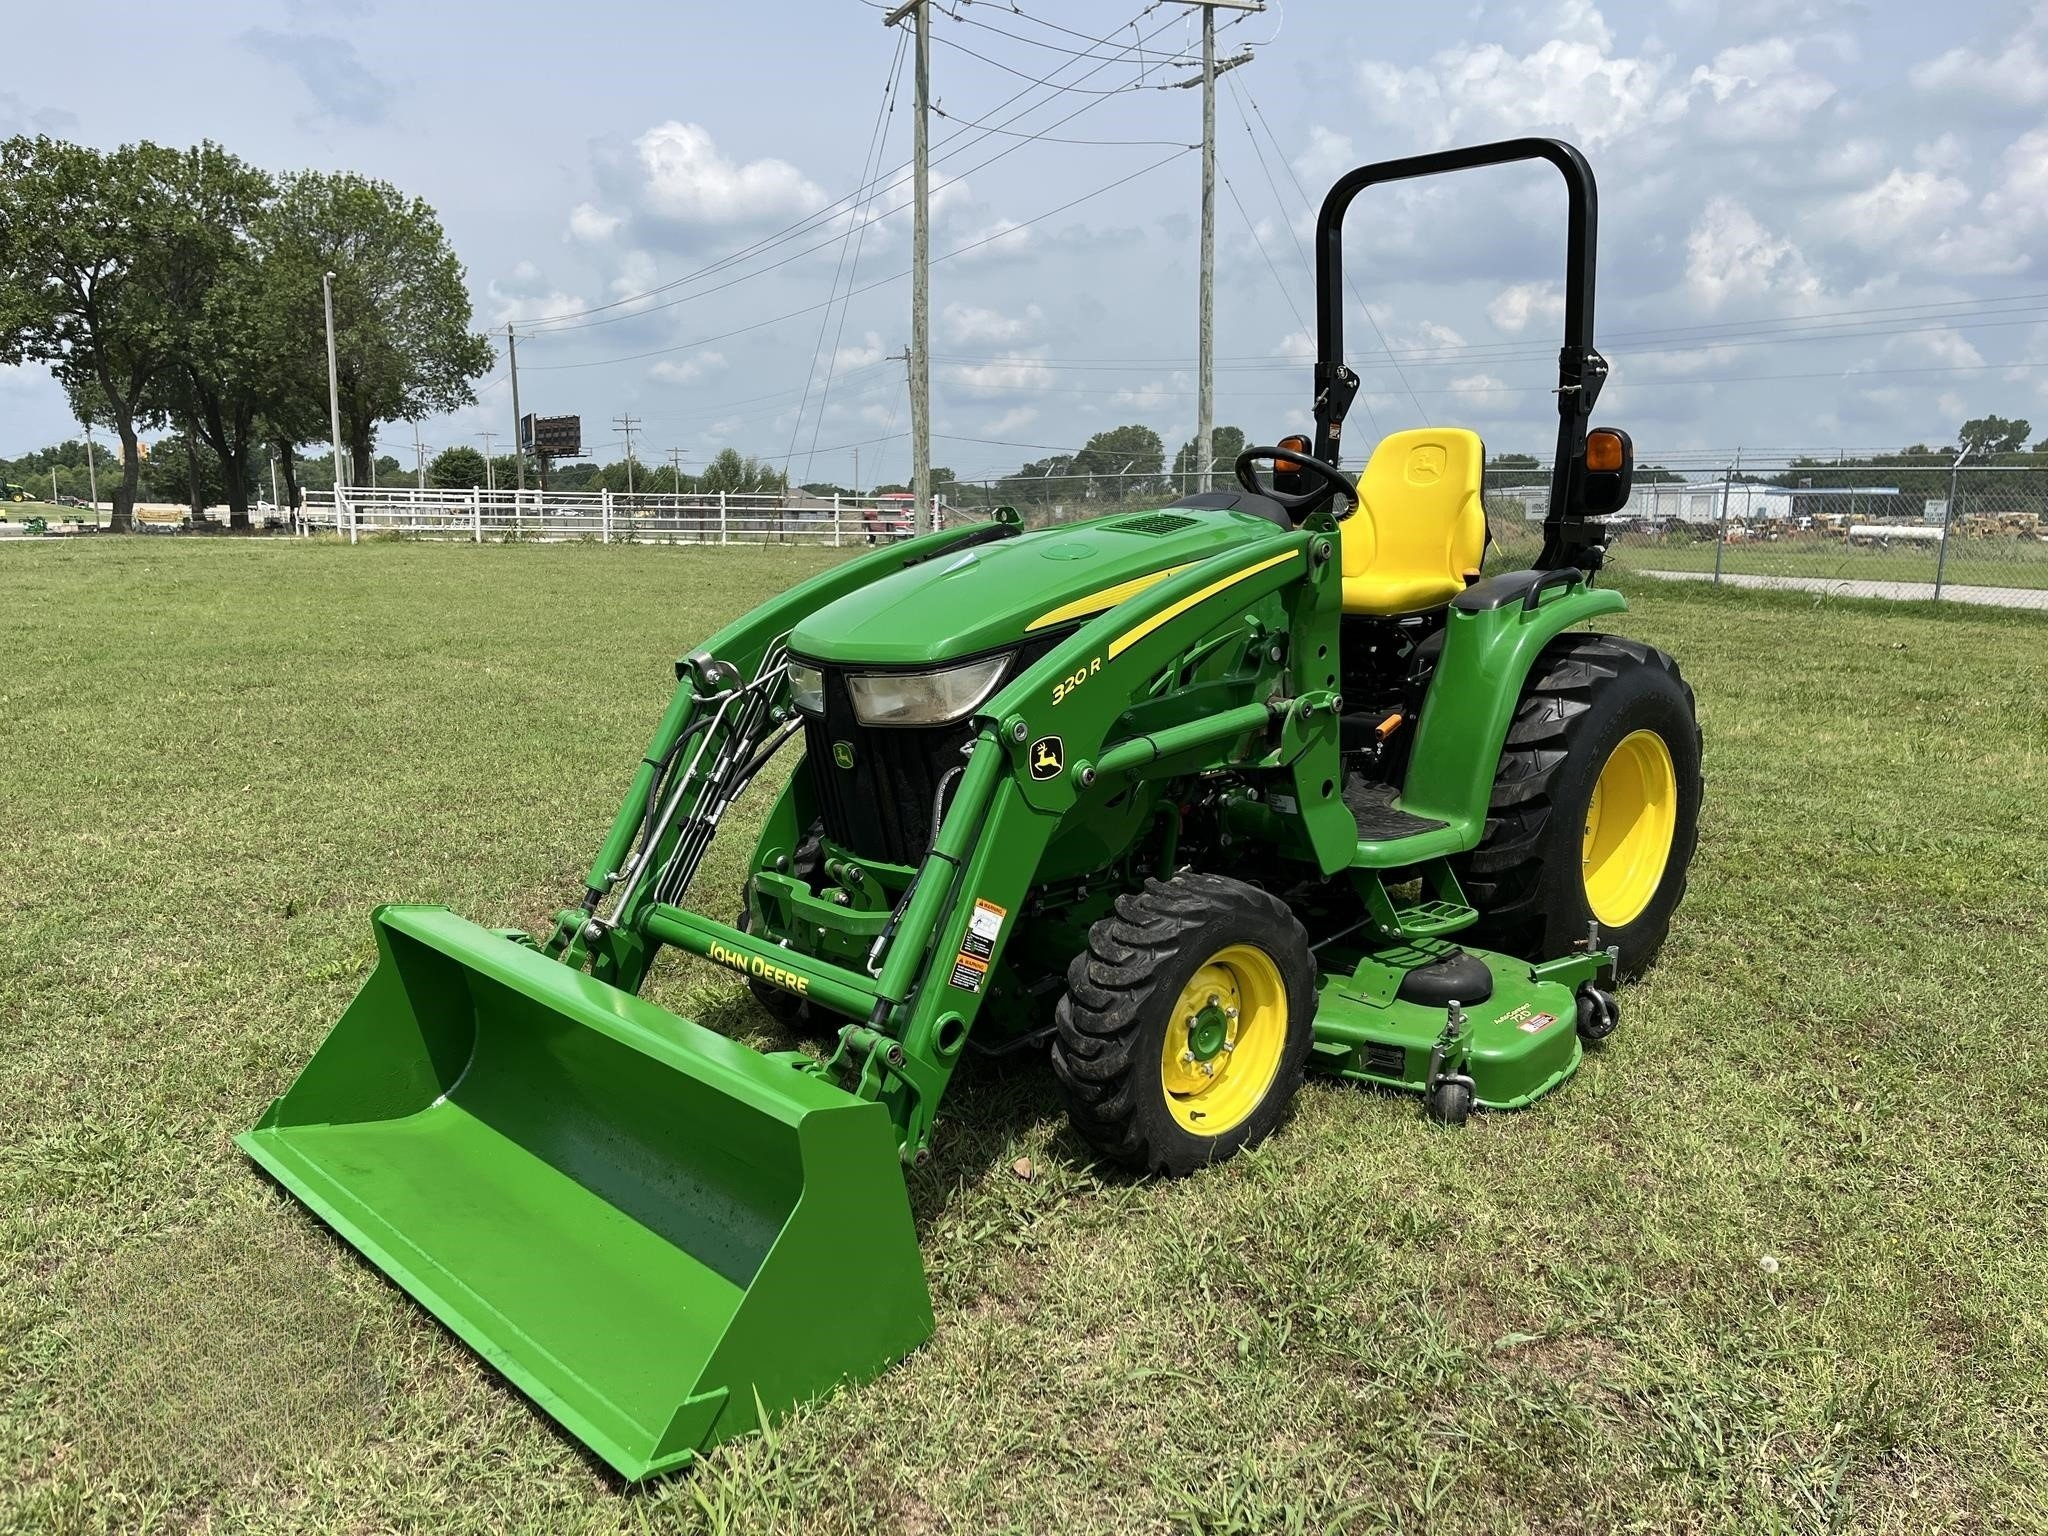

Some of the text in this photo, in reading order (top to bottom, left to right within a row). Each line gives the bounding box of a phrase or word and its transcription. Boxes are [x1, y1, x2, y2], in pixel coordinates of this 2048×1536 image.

[1052, 657, 1101, 706] 320 R
[706, 941, 809, 996] JOHN DEERE
